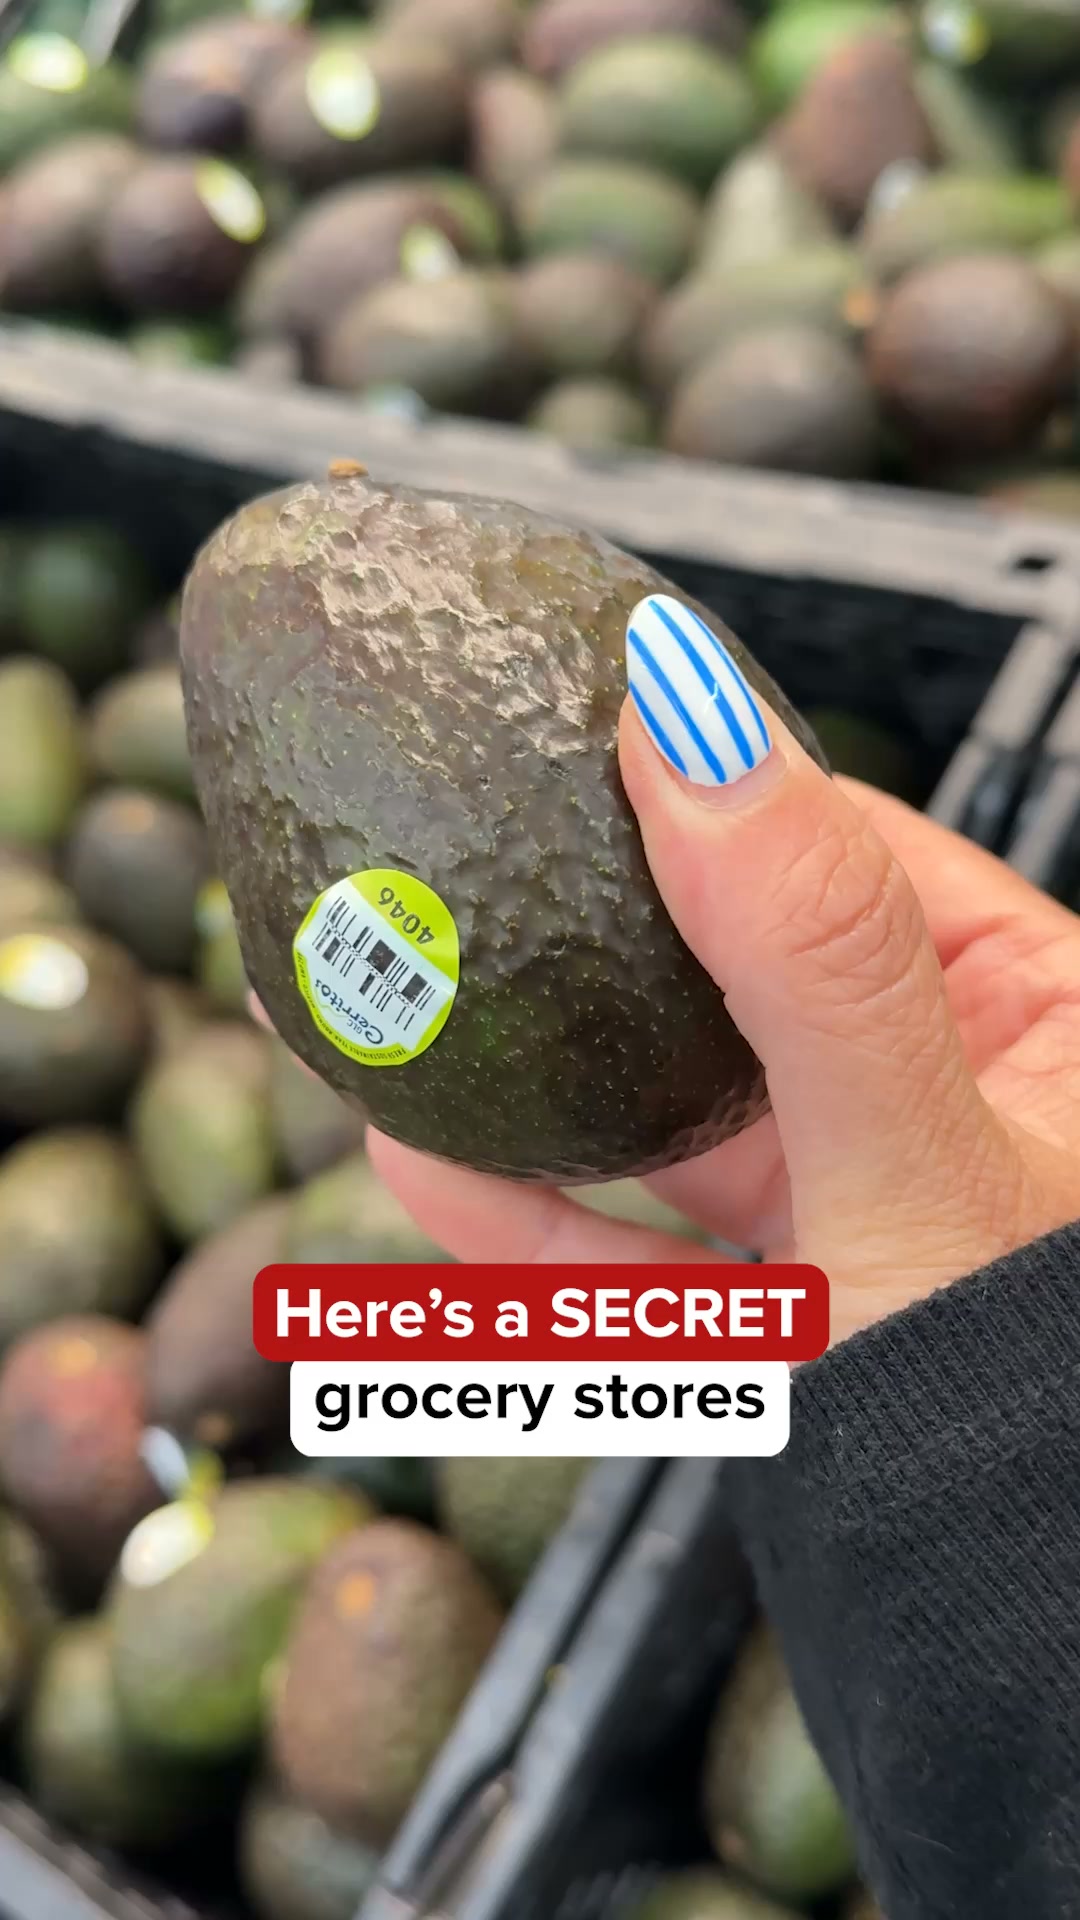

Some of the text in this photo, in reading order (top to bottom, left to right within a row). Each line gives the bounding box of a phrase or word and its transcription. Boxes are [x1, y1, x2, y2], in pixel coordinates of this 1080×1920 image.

[378, 887, 435, 945] 4046
[315, 979, 384, 1045] Cerritos
[346, 1019, 363, 1034] GLC
[335, 1035, 348, 1048] YEAR
[387, 1047, 406, 1059] FRESH
